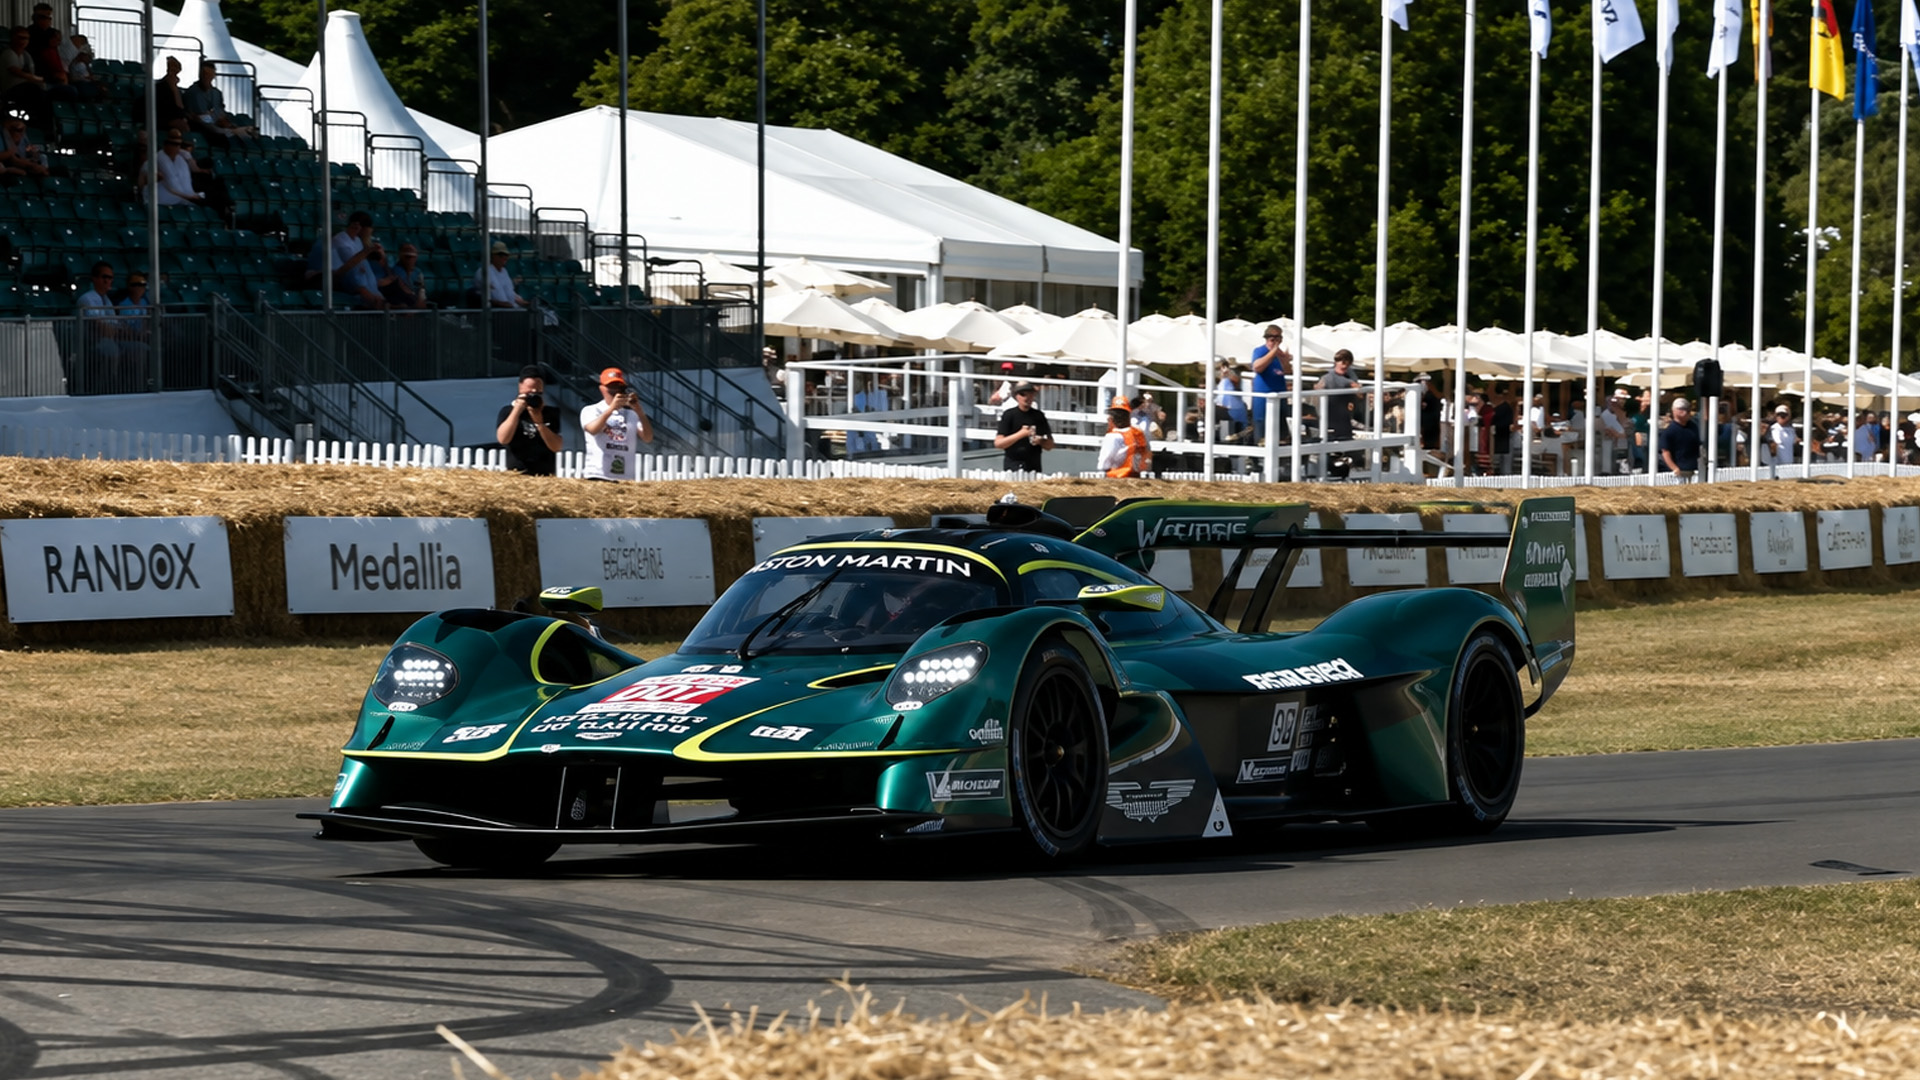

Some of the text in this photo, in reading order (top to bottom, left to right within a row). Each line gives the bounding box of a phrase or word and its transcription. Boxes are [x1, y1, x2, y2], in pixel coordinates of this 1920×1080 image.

[43, 543, 201, 593] RANDOX
[329, 542, 462, 591] Medallia
[836, 554, 971, 577] MARTIN
[605, 684, 725, 702] 007
